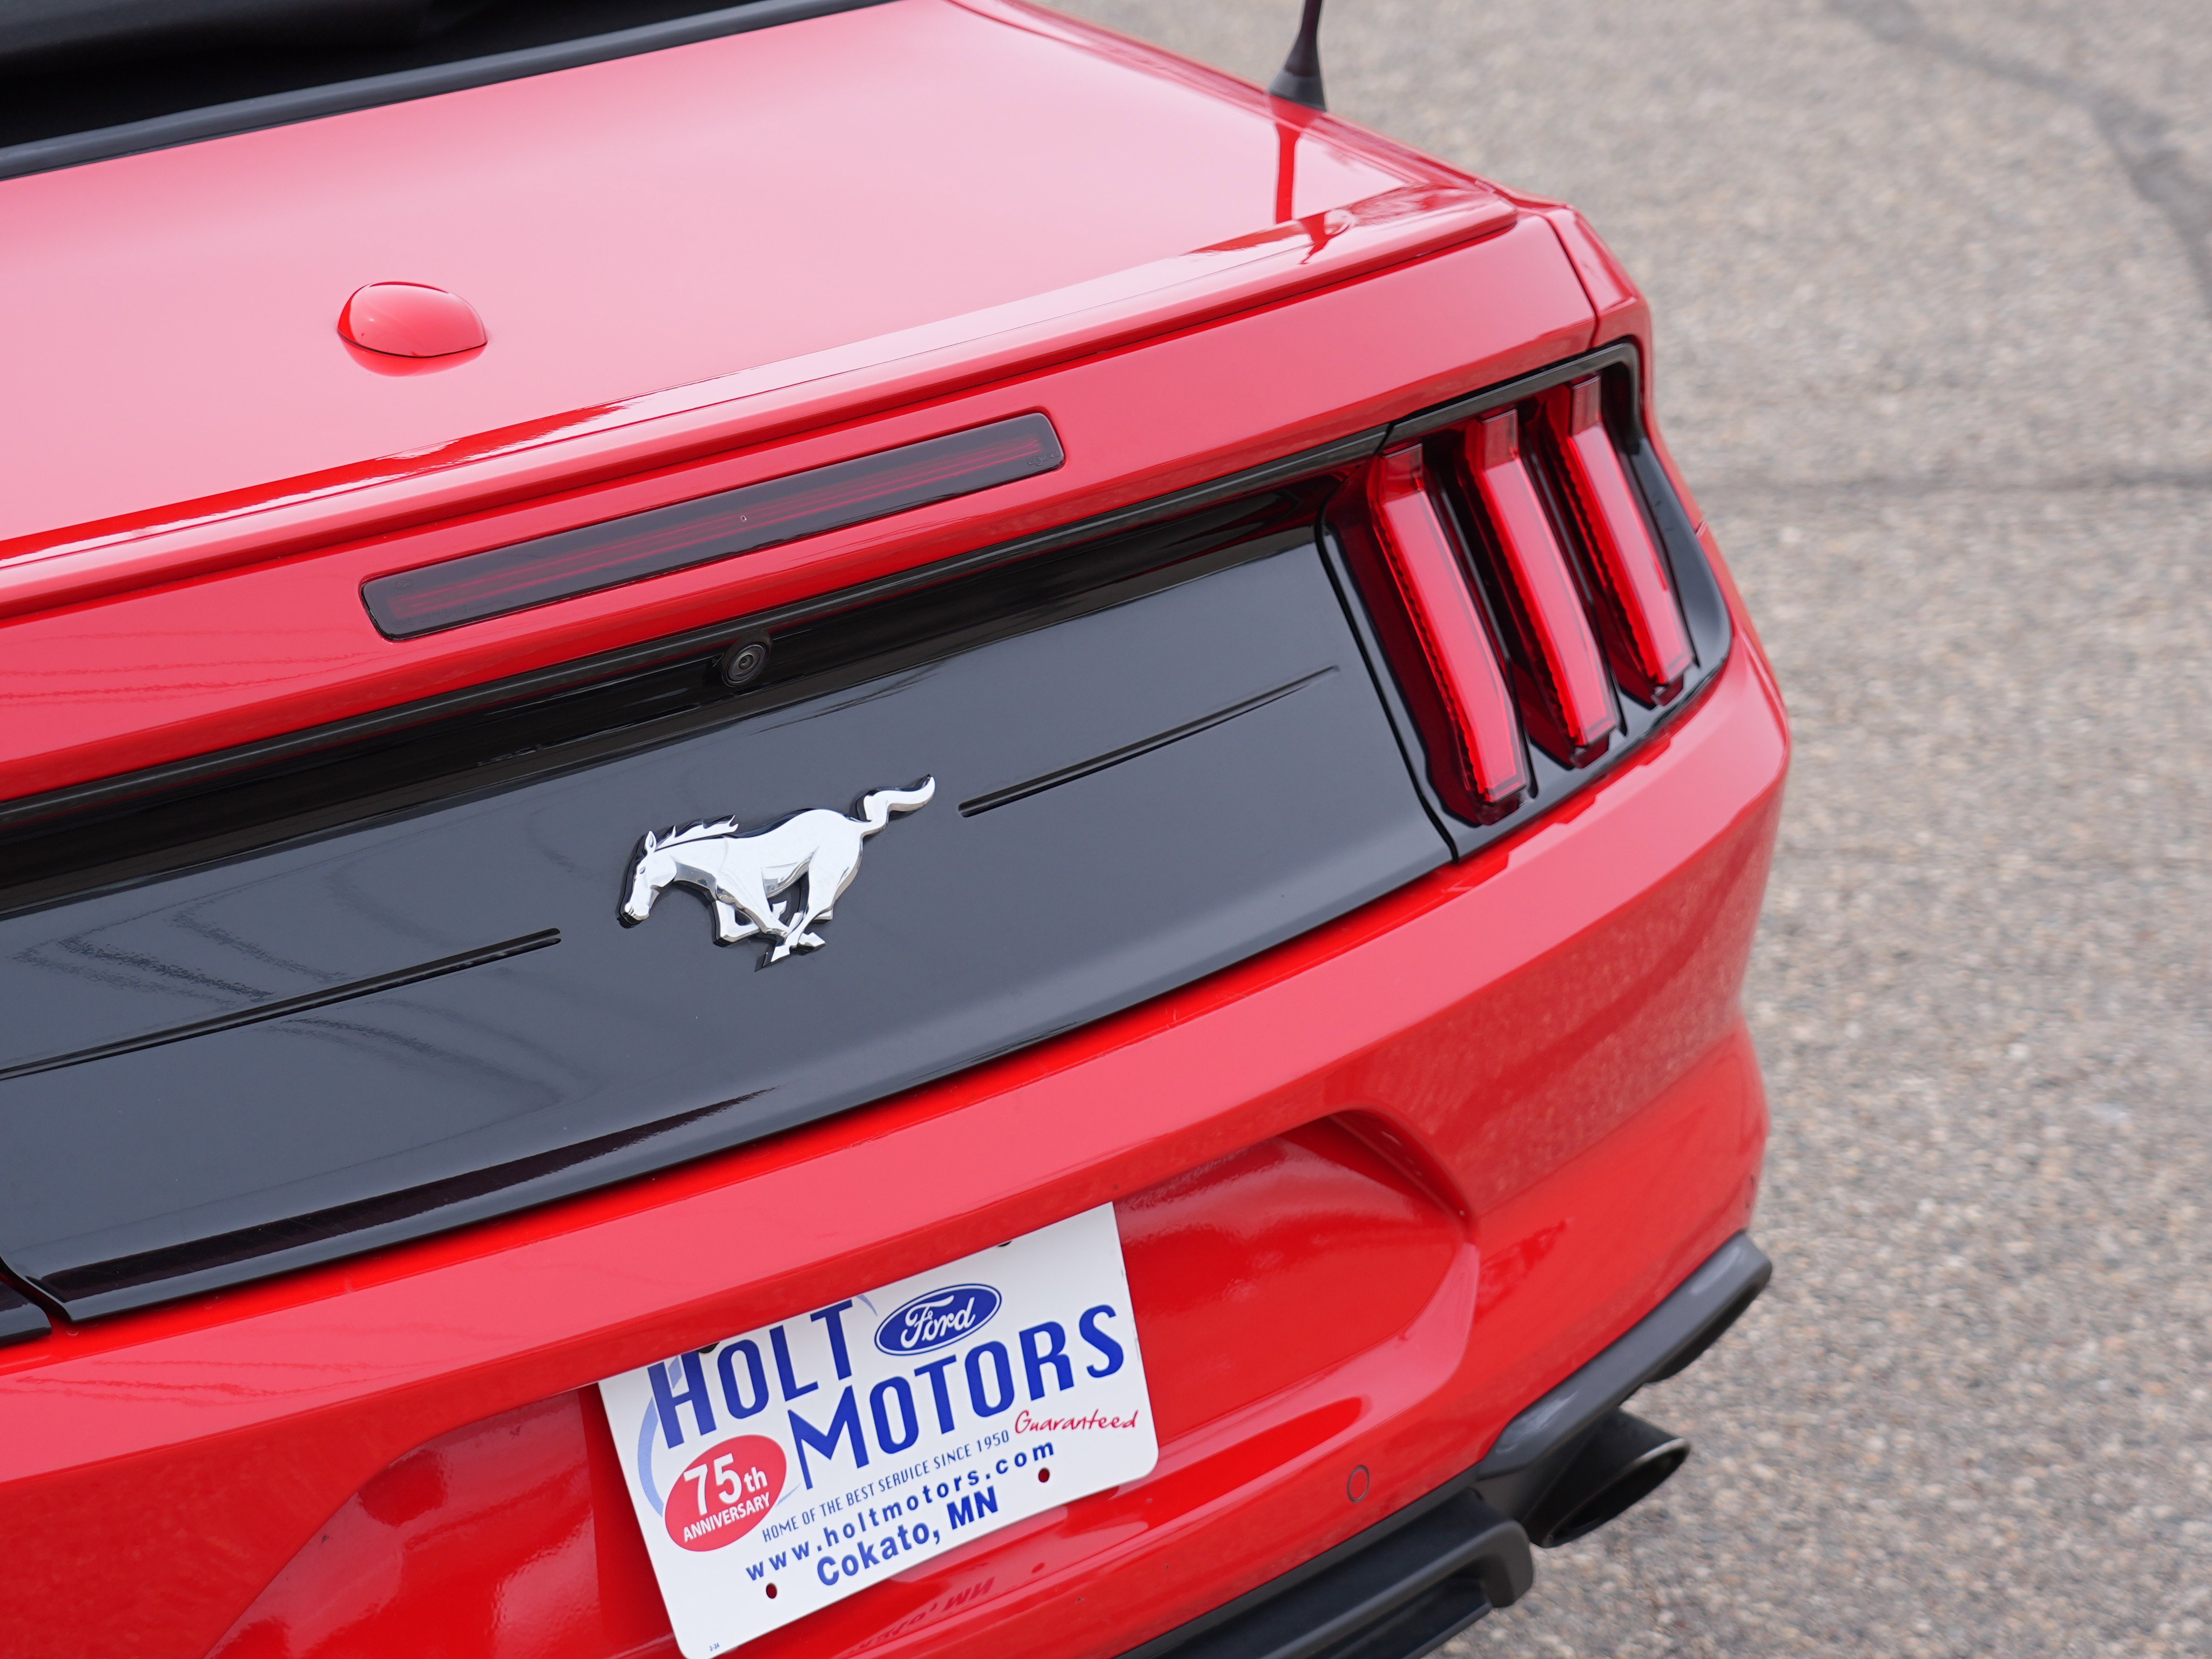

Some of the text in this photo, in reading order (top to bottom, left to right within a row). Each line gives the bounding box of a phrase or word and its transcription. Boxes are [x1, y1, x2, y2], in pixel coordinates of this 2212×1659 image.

[901, 1296, 976, 1348] Ford
[648, 1299, 853, 1449] HOLT
[787, 1304, 1124, 1491] MOTORS
[1015, 1408, 1139, 1434] Guaranteed
[683, 1453, 768, 1516] 75th
[683, 1492, 770, 1543] ANNIVERSARY
[745, 1441, 1054, 1581] www.holtmotors.com
[762, 1429, 1010, 1542] HOME OF THE BEST SERVICE SINCE 1950
[817, 1485, 999, 1586] Cokato, MN
